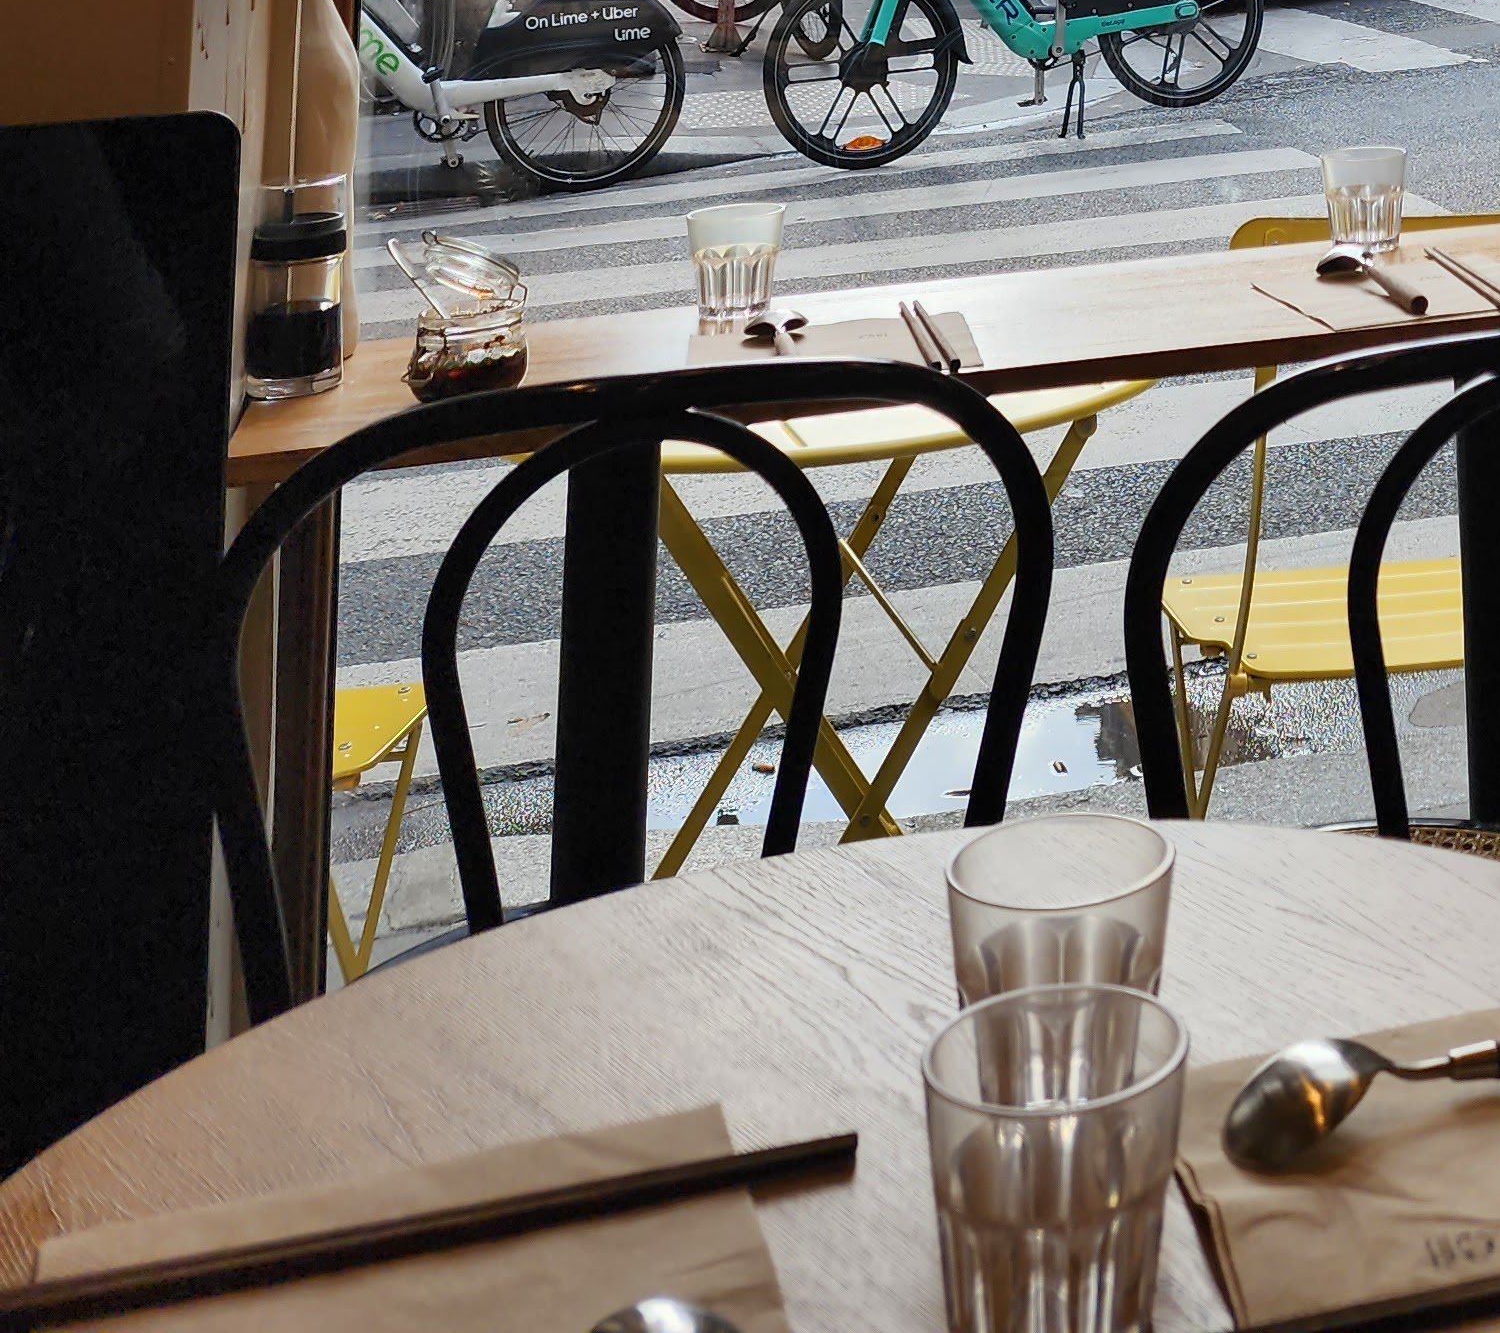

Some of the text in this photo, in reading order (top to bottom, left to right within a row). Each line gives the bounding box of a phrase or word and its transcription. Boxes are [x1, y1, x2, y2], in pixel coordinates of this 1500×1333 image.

[525, 6, 639, 30] On Lime + Uber
[614, 26, 651, 41] Lime
